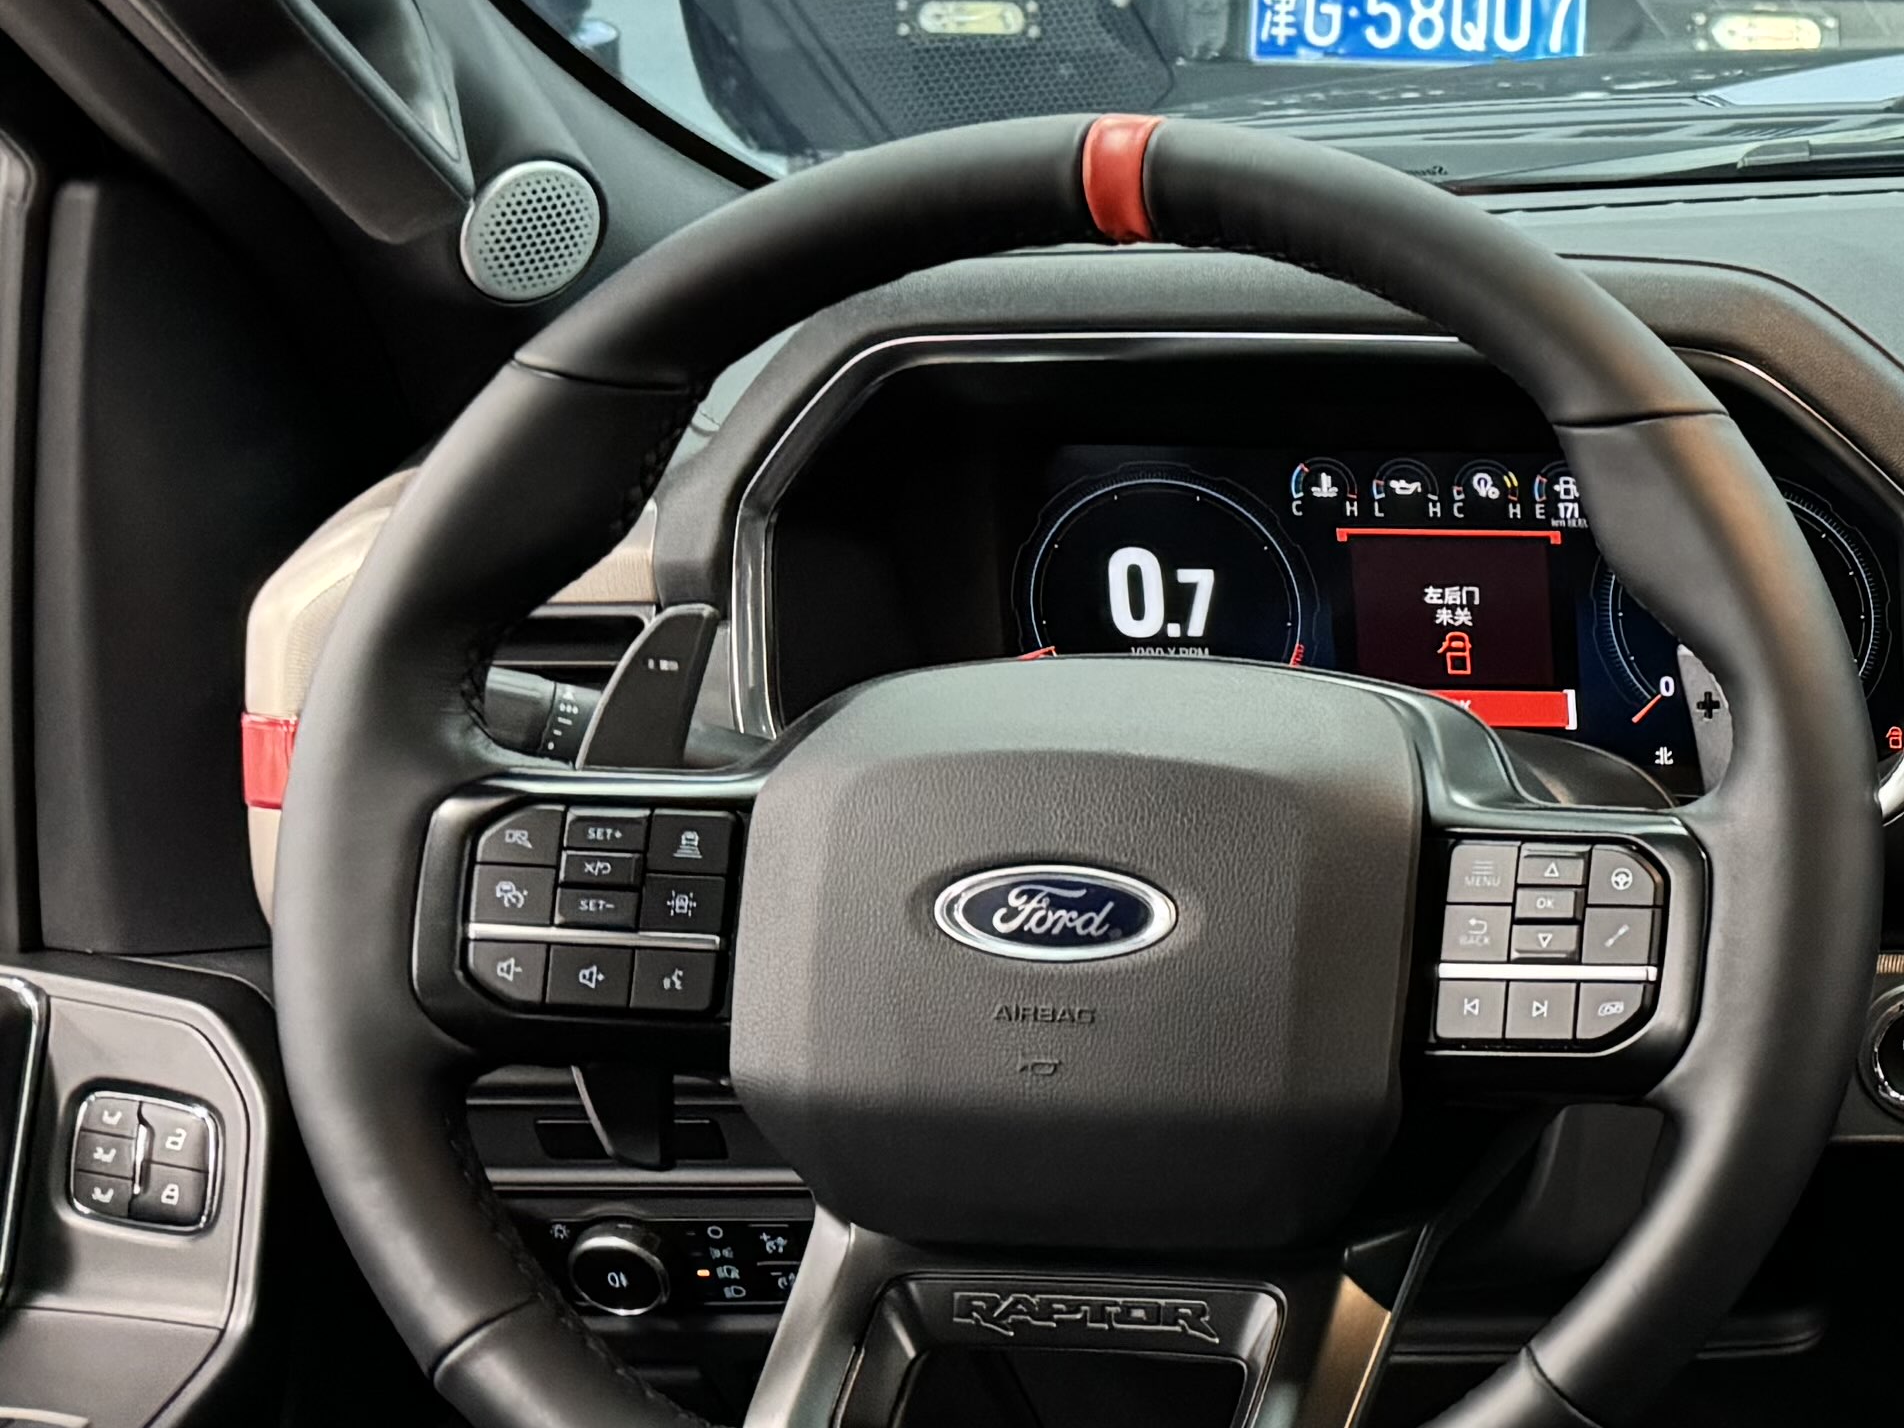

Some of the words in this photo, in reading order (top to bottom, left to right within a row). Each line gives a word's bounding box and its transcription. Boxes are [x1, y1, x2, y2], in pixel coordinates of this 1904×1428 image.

[1292, 501, 1303, 516] C
[1345, 501, 1358, 517] H
[1374, 502, 1385, 517] L
[1428, 502, 1441, 518] H
[1453, 502, 1465, 518] C
[1508, 503, 1521, 518] H
[1535, 503, 1546, 519] E
[1557, 502, 1579, 519] 171
[1108, 547, 1214, 639] 0.7
[1424, 586, 1480, 605] 左后门
[1435, 608, 1473, 626] 未关
[1659, 676, 1675, 697] 0
[1655, 746, 1674, 765] 北
[1464, 875, 1501, 887] MENU
[992, 884, 1115, 937] Ford
[1536, 897, 1554, 909] OK
[993, 1003, 1097, 1025] AIRBAG
[953, 1291, 1220, 1345] RAPTOR
